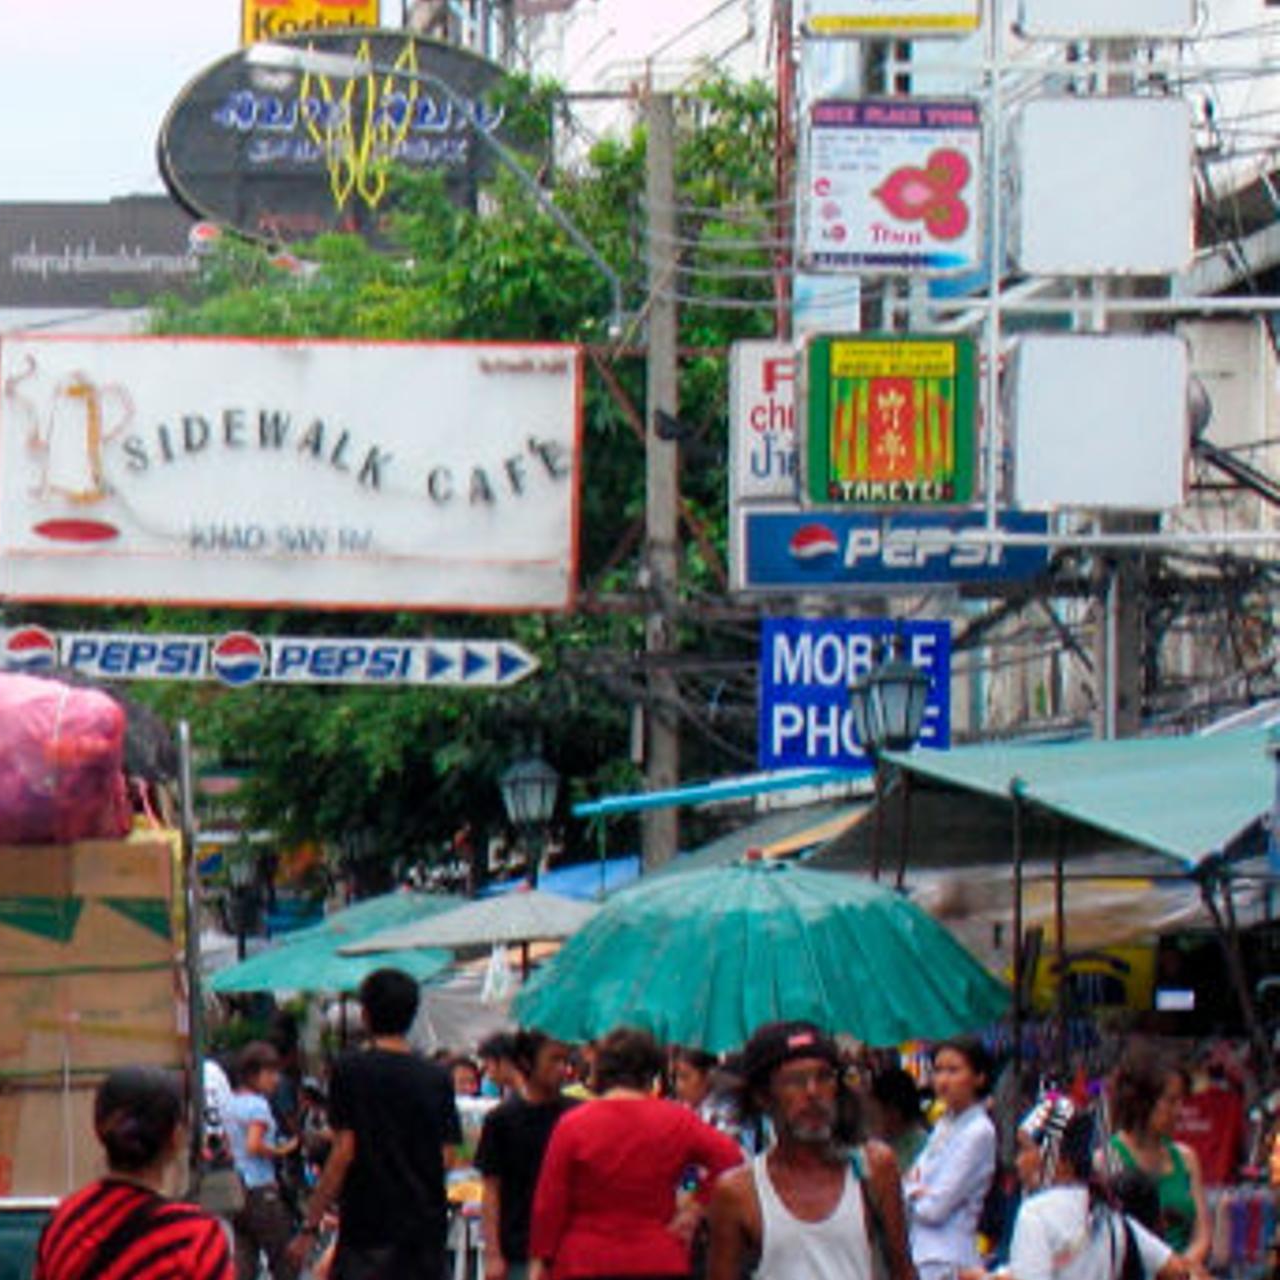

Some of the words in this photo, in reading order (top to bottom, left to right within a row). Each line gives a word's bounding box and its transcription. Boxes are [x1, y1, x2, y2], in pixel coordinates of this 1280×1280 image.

[124, 408, 393, 491] SIDEWALK
[843, 531, 1008, 569] PEPSI
[67, 641, 208, 678] PEPSI
[274, 643, 413, 680] PEPSI
[771, 632, 937, 686] MOBE
[771, 703, 941, 757] PHOE
